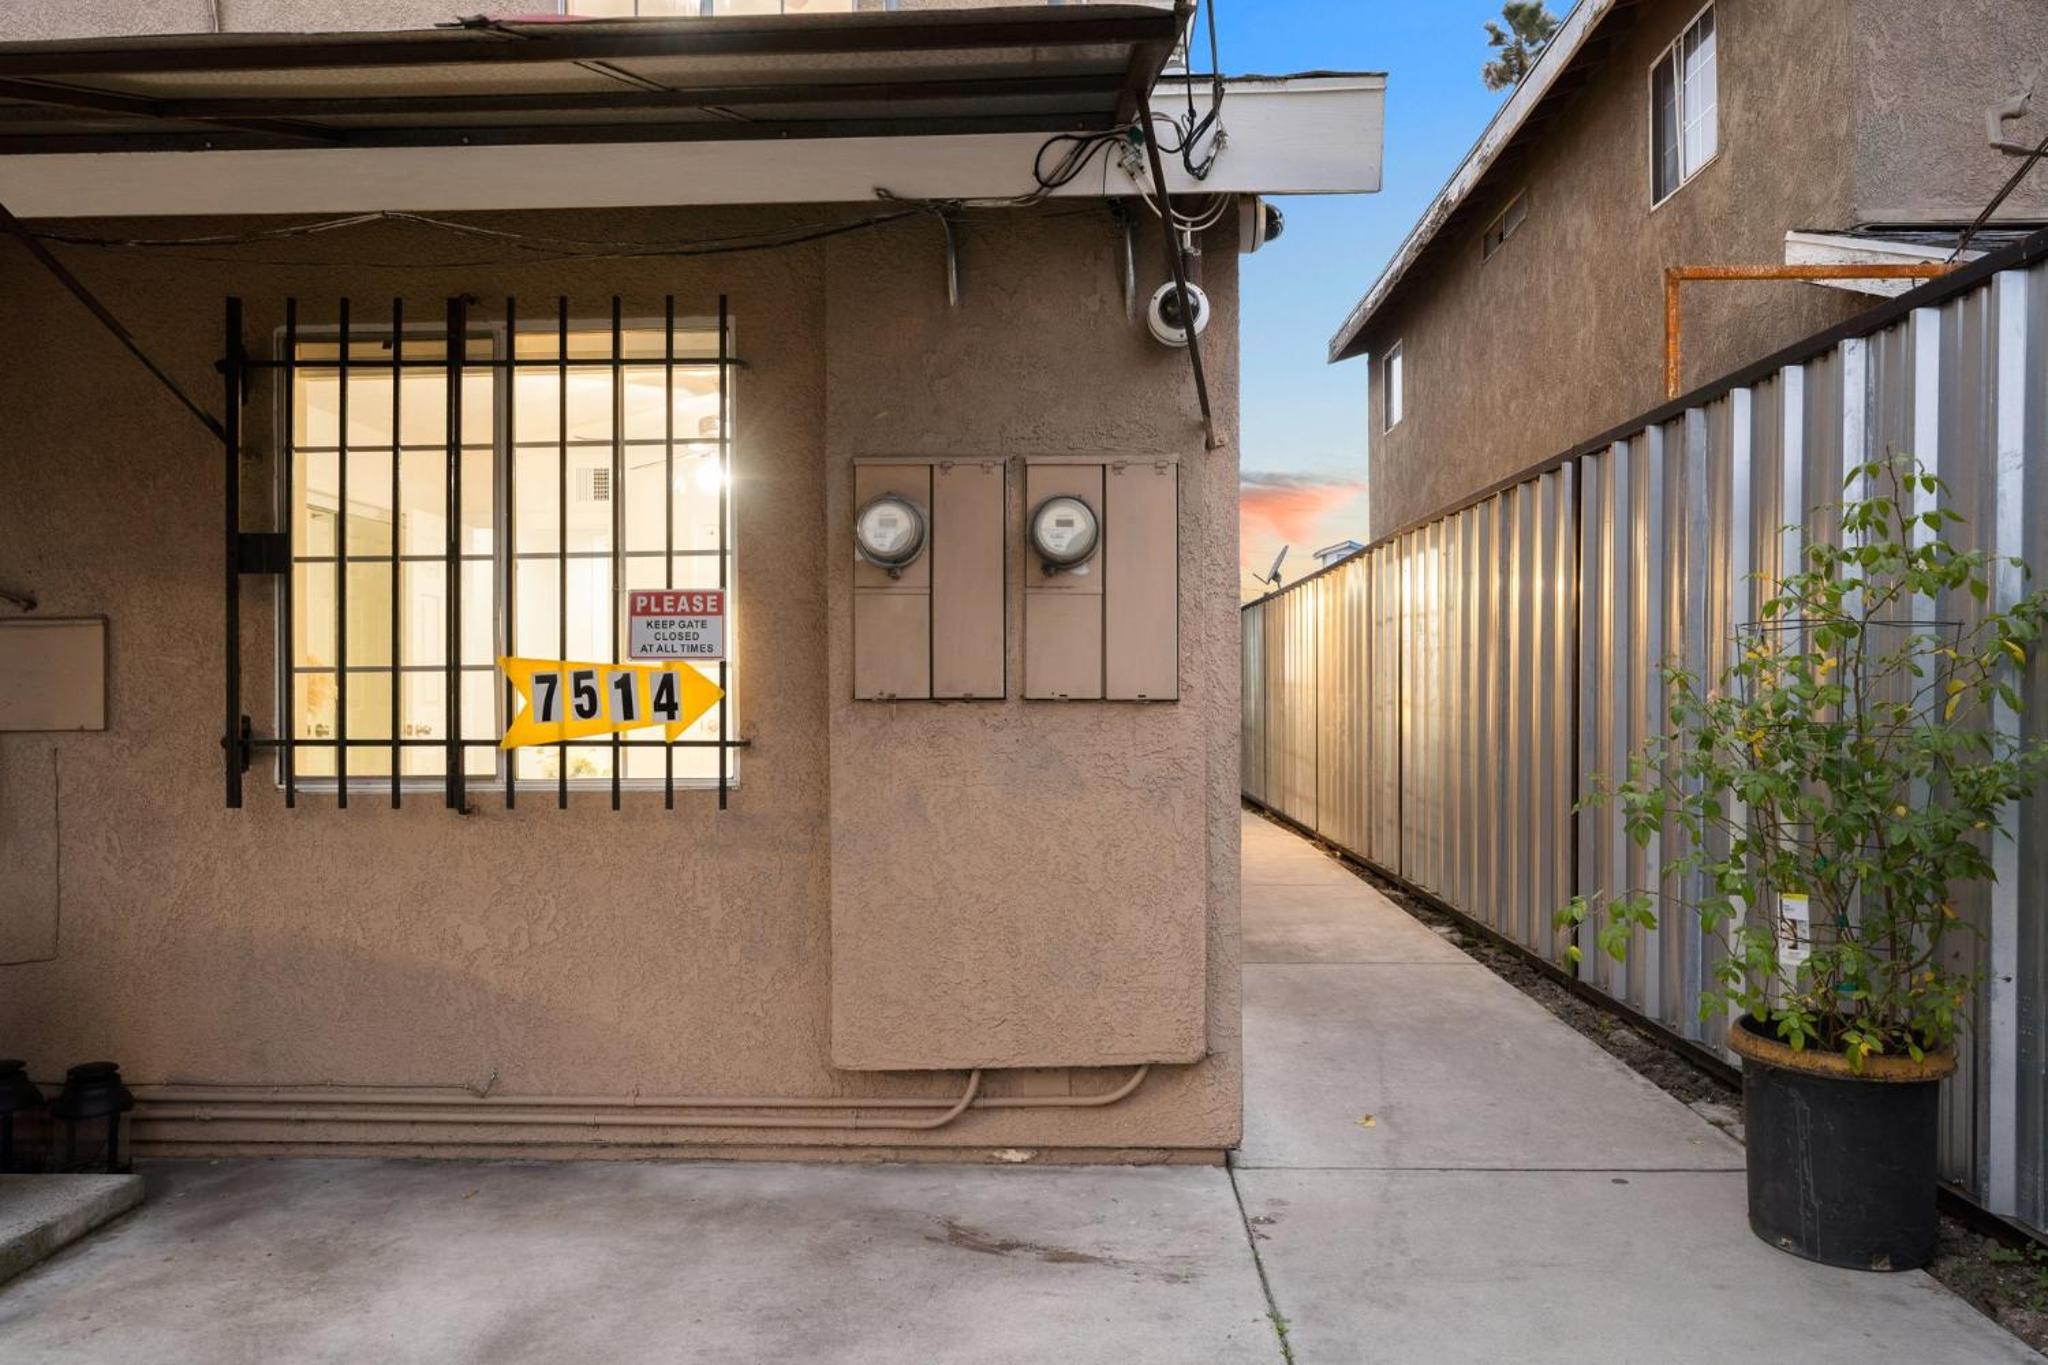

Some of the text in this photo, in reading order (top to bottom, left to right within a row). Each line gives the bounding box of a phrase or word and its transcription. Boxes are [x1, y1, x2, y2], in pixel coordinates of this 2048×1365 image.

[635, 595, 719, 613] PLEASE
[646, 619, 708, 629] KEEP GATE
[654, 631, 700, 641] CLOSED
[640, 643, 714, 653] AT ALL TIMES
[534, 670, 679, 722] 7514
